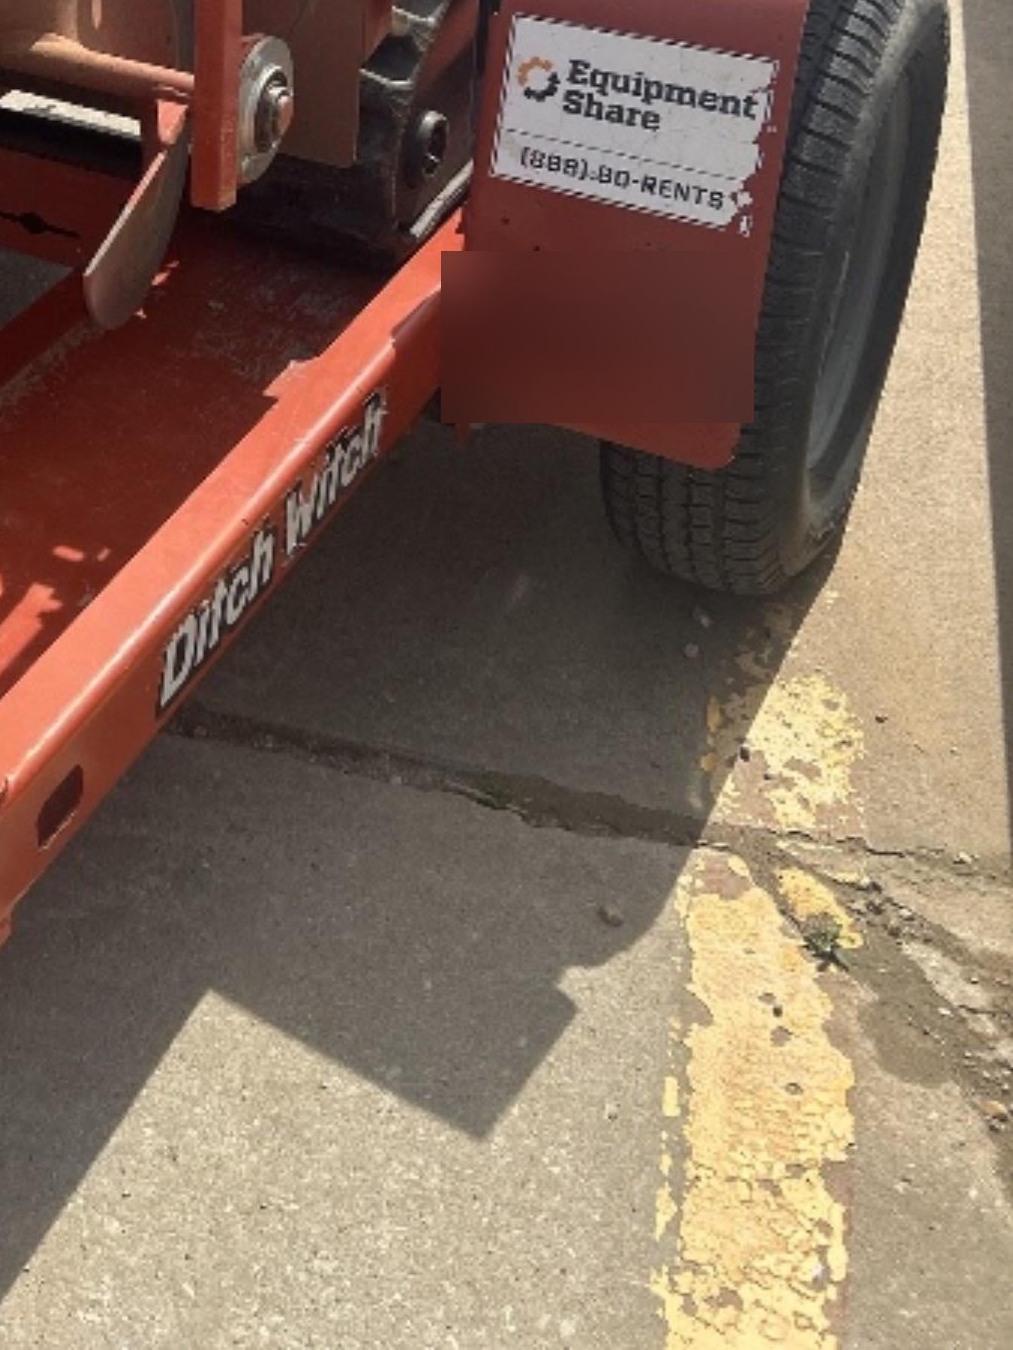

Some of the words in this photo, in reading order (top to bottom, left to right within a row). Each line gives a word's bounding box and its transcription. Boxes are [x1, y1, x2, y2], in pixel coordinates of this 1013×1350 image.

[562, 89, 661, 132] Share
[565, 58, 758, 121] Equipment
[157, 522, 276, 710] Ditch
[285, 385, 386, 558] Witch
